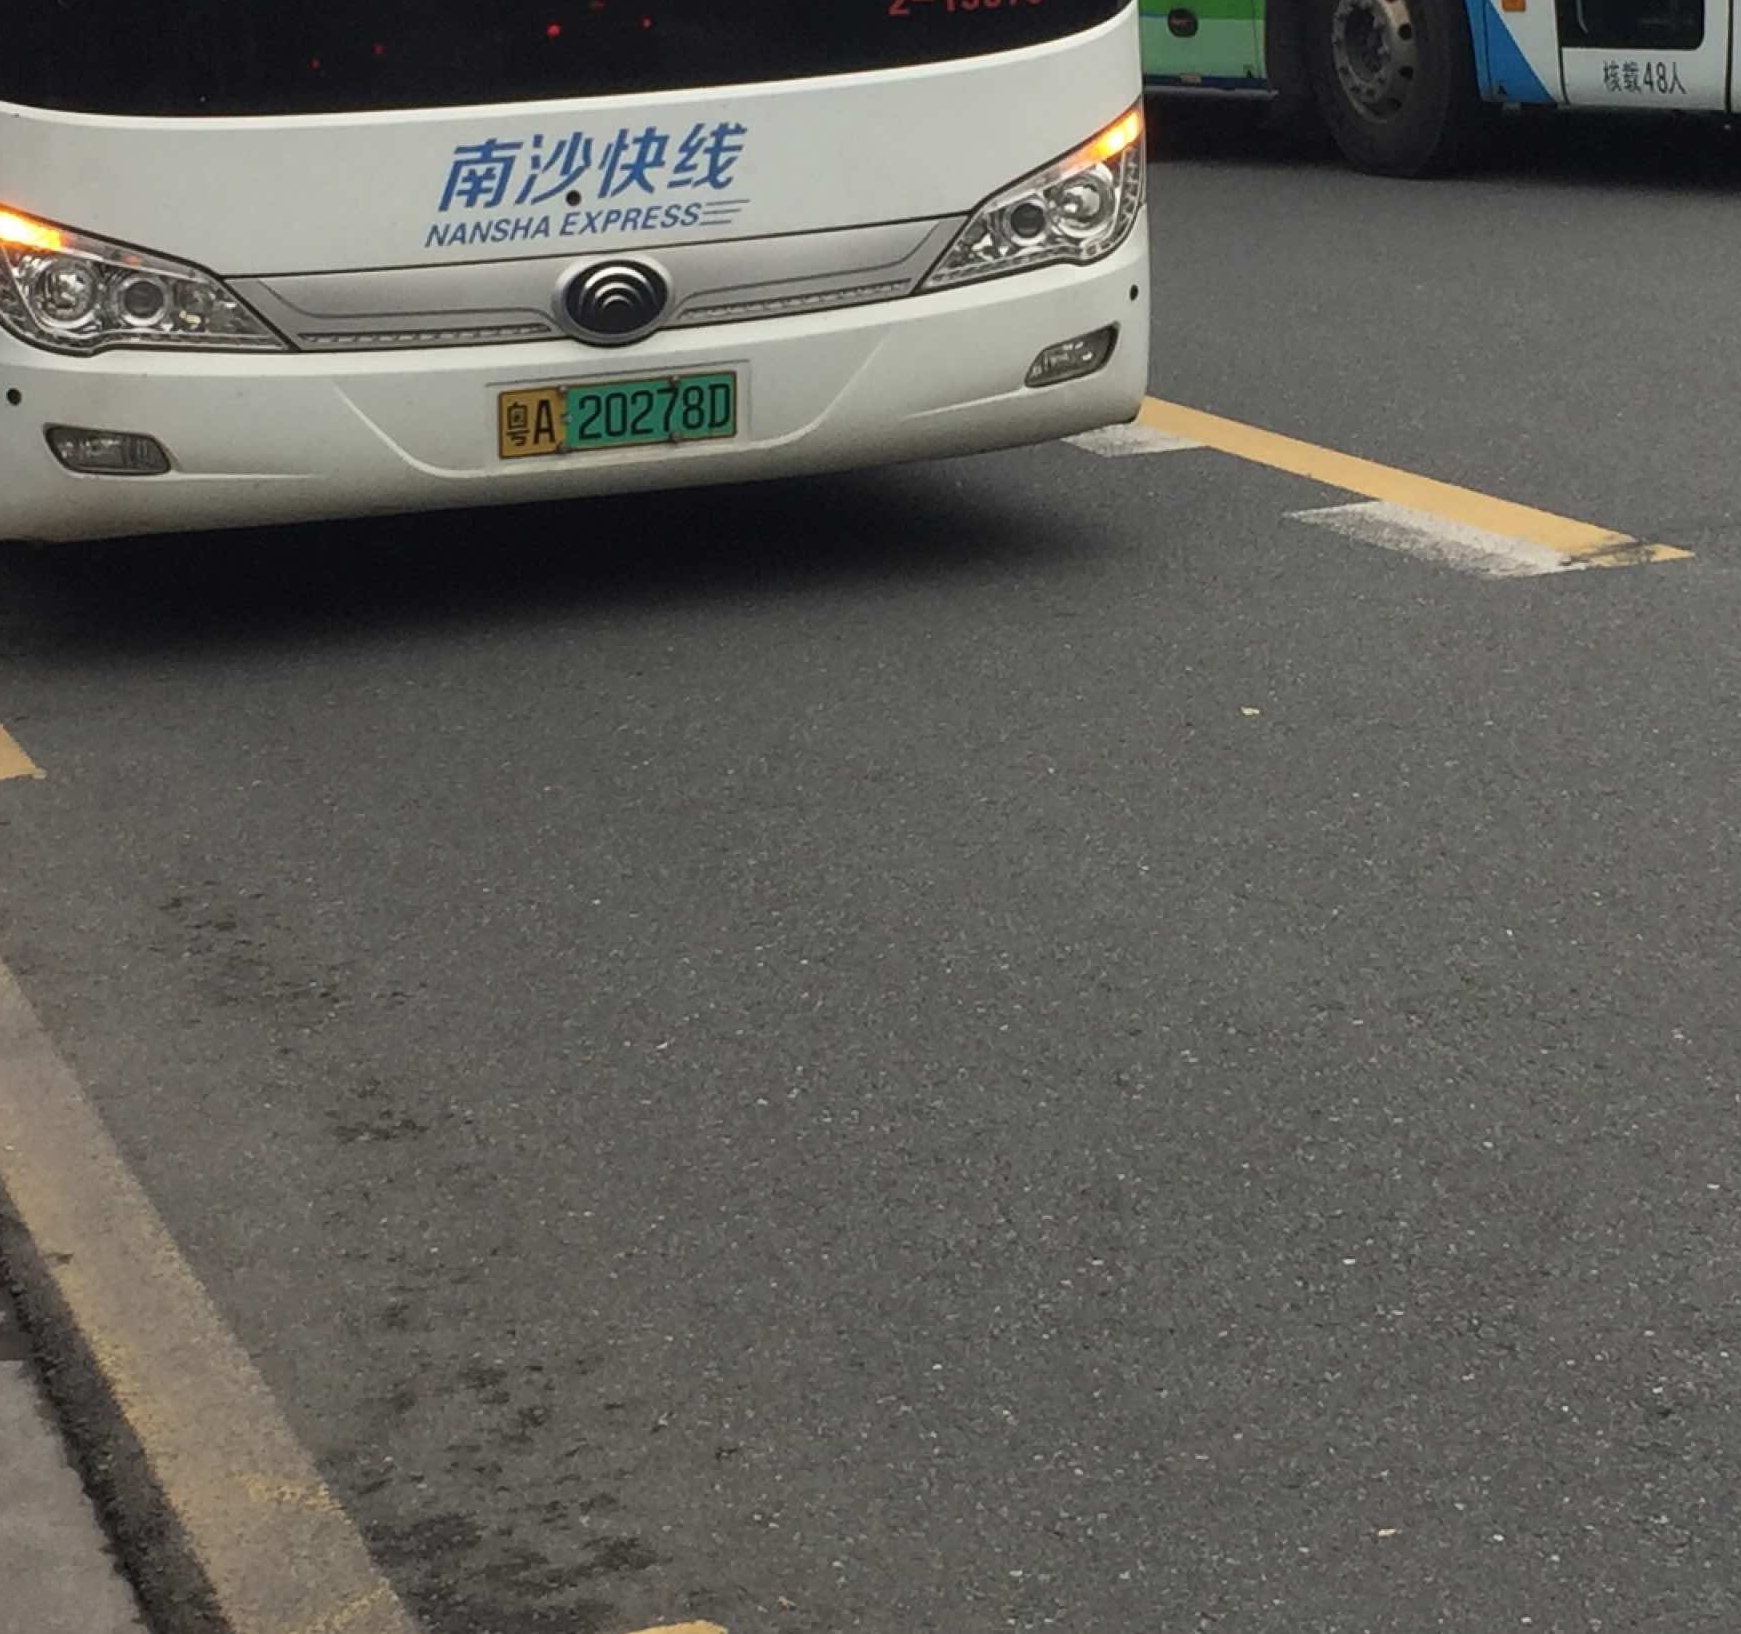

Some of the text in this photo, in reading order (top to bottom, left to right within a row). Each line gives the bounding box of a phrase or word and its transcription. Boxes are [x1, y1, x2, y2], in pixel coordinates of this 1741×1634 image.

[1602, 60, 1688, 94] 核载48人
[438, 121, 748, 212] 南沙快线
[424, 202, 703, 248] NANSHA EXPRESS
